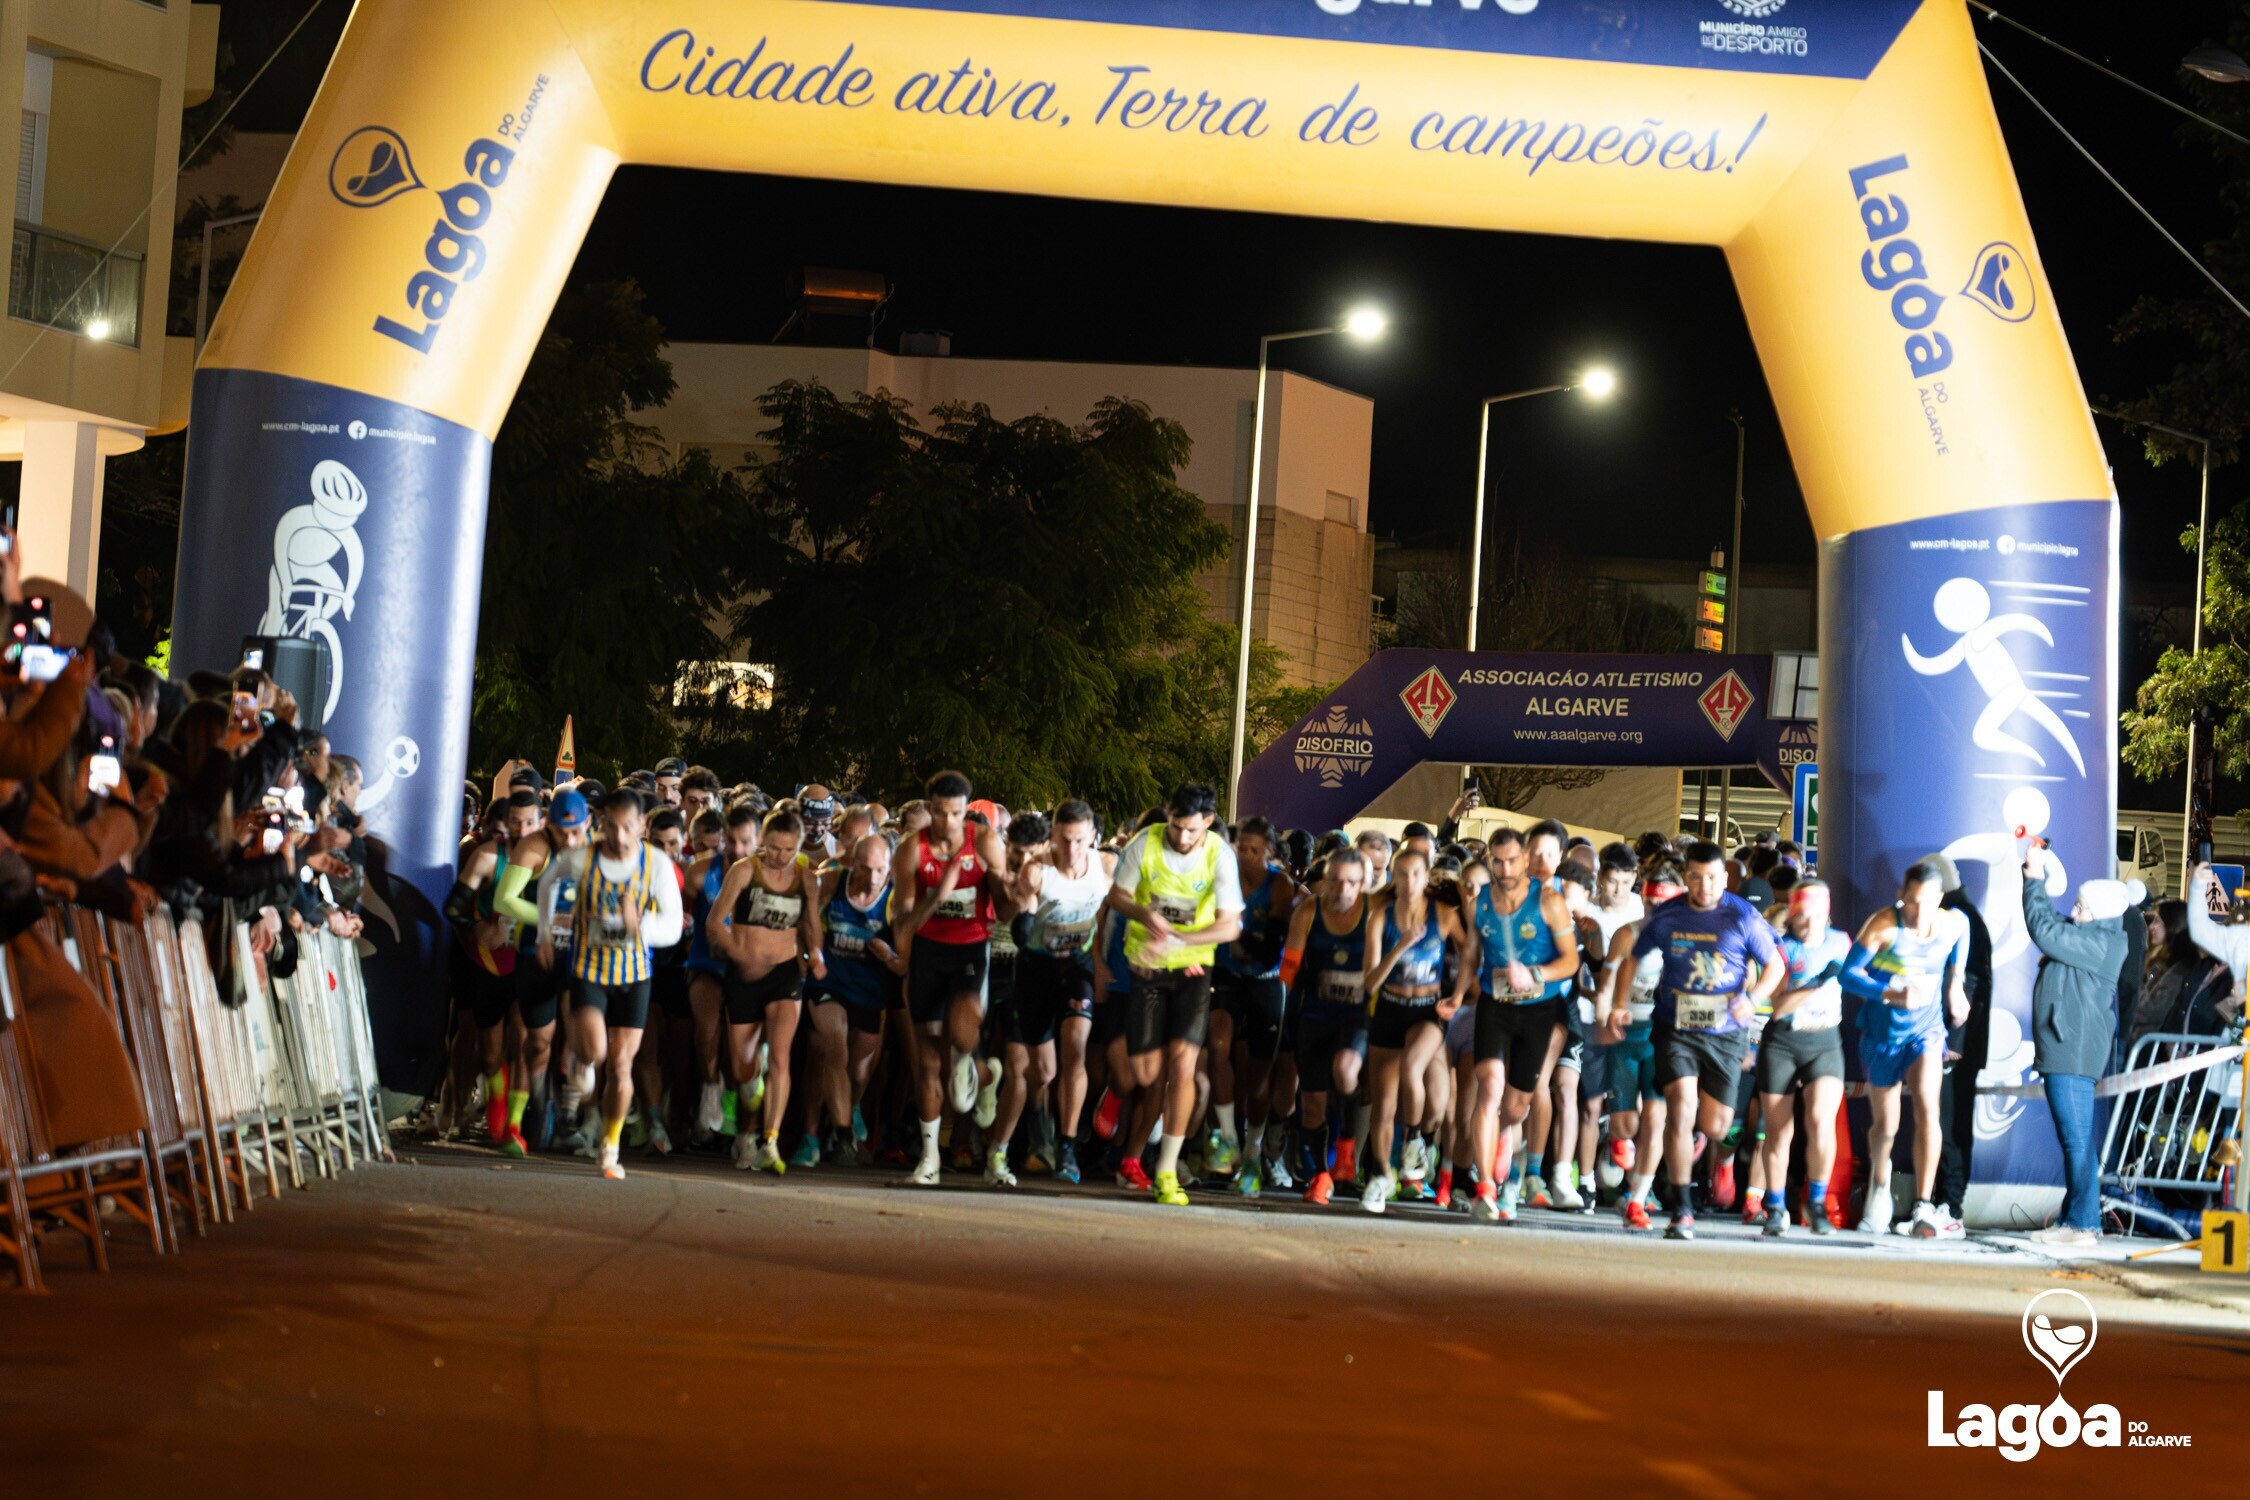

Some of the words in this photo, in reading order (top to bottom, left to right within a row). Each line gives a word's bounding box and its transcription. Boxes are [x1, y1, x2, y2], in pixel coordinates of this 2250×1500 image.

[1699, 21, 1765, 37] MUNICÍPIO
[1766, 26, 1807, 38] AMIGO
[1713, 34, 1808, 57] DESPORTO
[514, 73, 550, 143] ALGARVE
[640, 28, 874, 107] Cidade
[893, 57, 1070, 127] ativa,
[1094, 65, 1269, 138] Terra
[1299, 82, 1380, 145] de
[1410, 111, 1768, 177] campeões!
[498, 113, 515, 136] DO
[372, 138, 516, 355] Lagoa
[1848, 153, 1954, 379] Lagoa
[1933, 382, 1949, 403] DO
[1918, 387, 1950, 456] ALGARVE
[1592, 672, 1703, 688] ATLETISMO
[1525, 697, 1629, 717] ALGARVE
[1296, 737, 1373, 754] DISOFRIO
[1513, 728, 1643, 744] www.aaalgarve.org
[1779, 748, 1817, 763] DISO
[2212, 1219, 2234, 1266] 1
